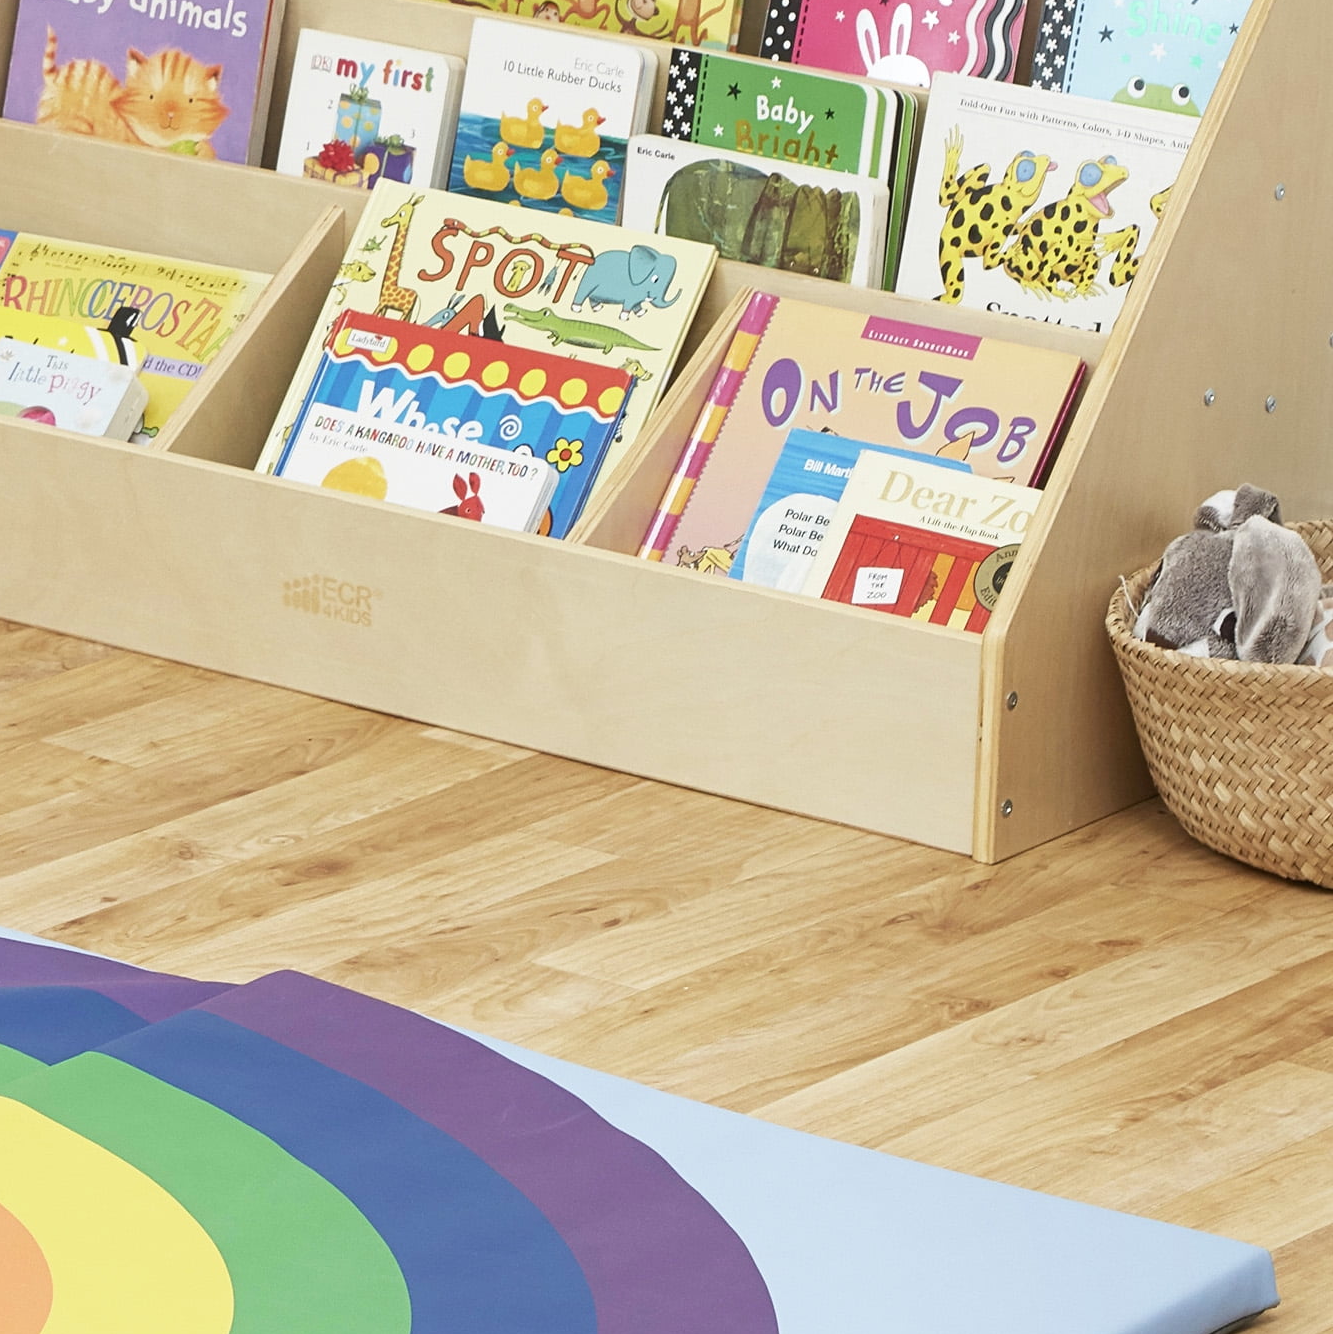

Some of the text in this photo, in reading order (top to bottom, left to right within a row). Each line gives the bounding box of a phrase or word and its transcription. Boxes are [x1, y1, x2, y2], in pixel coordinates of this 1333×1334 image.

[336, 58, 434, 92] my first
[503, 59, 622, 93] 10 Little Rubber Ducks
[574, 57, 625, 78] Eric Carle
[756, 94, 814, 135] Baby
[999, 107, 1016, 116] Fun
[1019, 110, 1038, 121] with
[1041, 114, 1079, 129] Patterns,
[1082, 122, 1112, 136] Colors,
[1133, 132, 1166, 147] Shapes,
[637, 146, 652, 156] Eric
[418, 228, 595, 304] SPOT
[3, 274, 192, 339] RHINOCEROS
[351, 332, 387, 349] Ladybird
[46, 354, 70, 372] This
[155, 359, 175, 373] the
[178, 363, 202, 379] CD!
[8, 361, 47, 386] little
[47, 372, 102, 406] piggy
[761, 358, 1037, 463] ON THE JOB
[309, 432, 319, 444] by
[322, 434, 339, 447] Eric
[314, 416, 343, 433] DOES
[346, 422, 353, 436] A
[354, 424, 414, 451] KANGAROO
[415, 438, 445, 459] HAVE
[445, 446, 454, 461] A
[456, 450, 505, 475] MOTHER,
[507, 461, 529, 478] TOO
[804, 458, 824, 473] Bill
[877, 469, 977, 519] Dear
[785, 508, 830, 527] Polar Be
[927, 517, 978, 537] Lift-the-Flap
[979, 530, 999, 540] Book
[778, 523, 824, 542] Polar Be
[773, 539, 818, 557] What Do
[322, 577, 372, 610] ECR
[866, 591, 887, 599] ZOO
